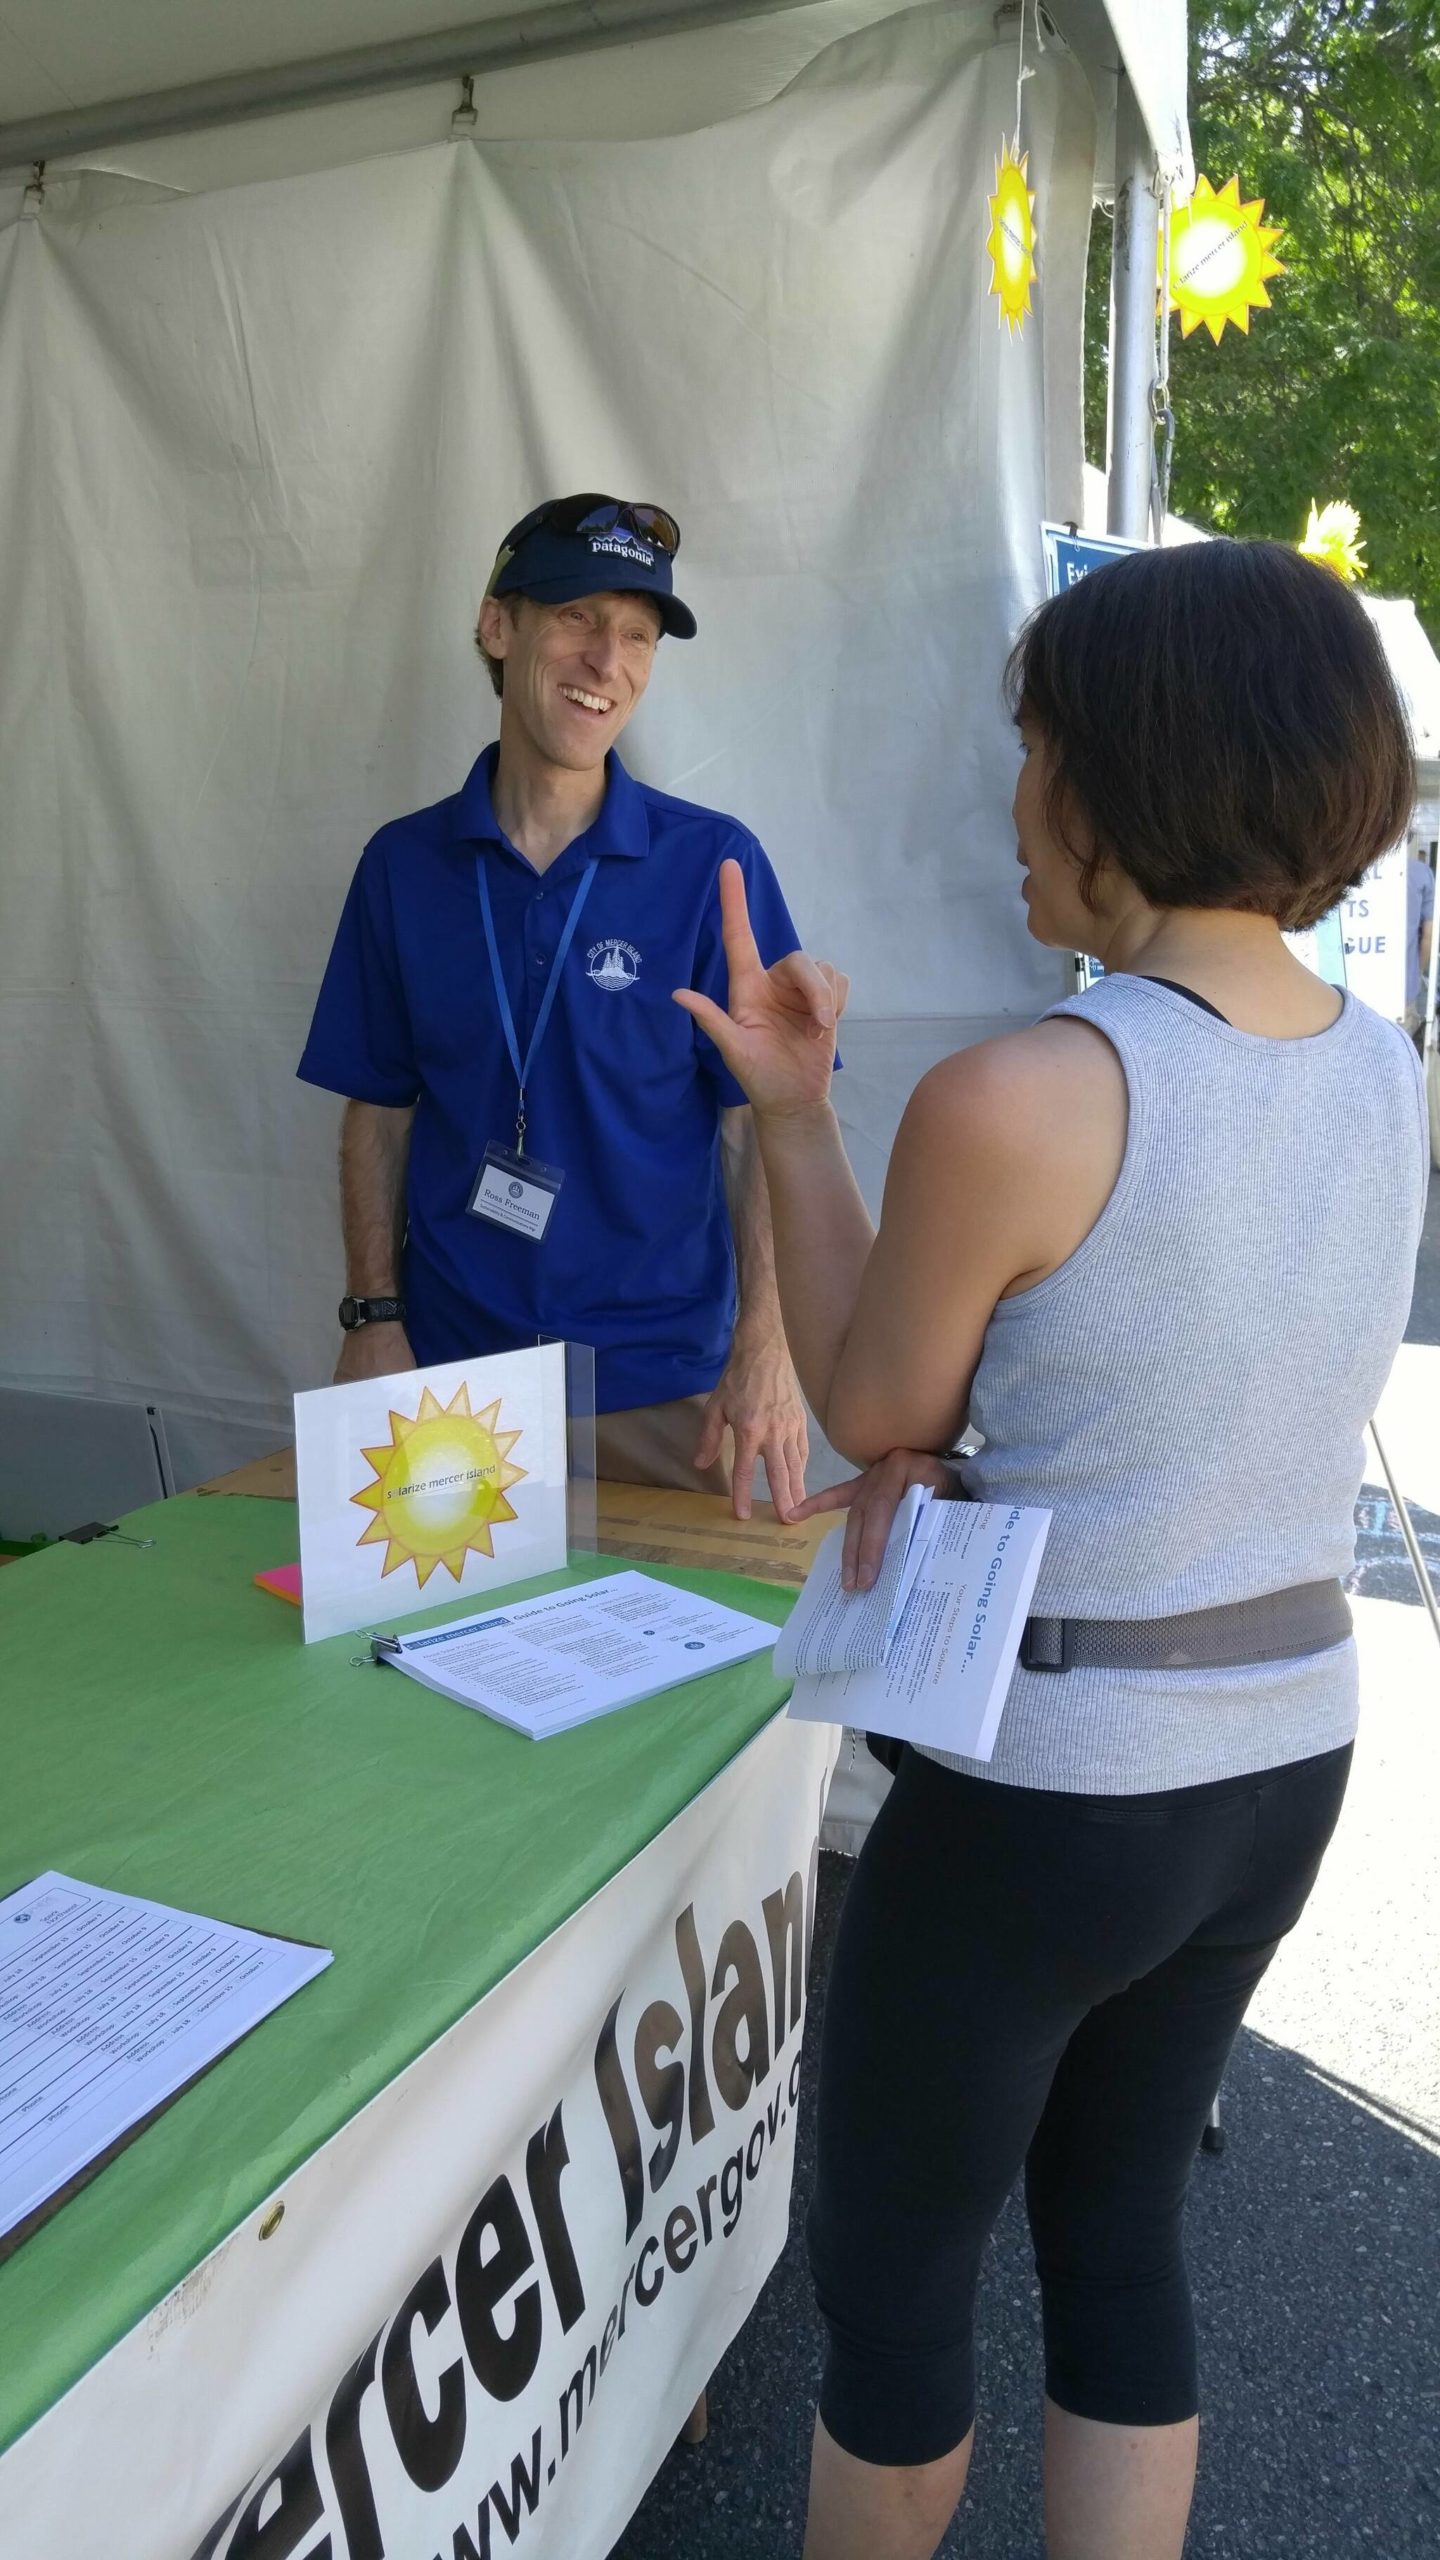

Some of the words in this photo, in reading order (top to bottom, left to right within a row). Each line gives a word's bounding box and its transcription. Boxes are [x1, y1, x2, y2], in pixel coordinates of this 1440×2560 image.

[592, 542, 652, 566] patagonia
[605, 938, 628, 949] MERCER
[484, 1188, 503, 1204] Ross
[504, 1198, 540, 1220] Freeman
[429, 1473, 465, 1489] mercer
[466, 1464, 496, 1480] island
[996, 1535, 1011, 1552] to
[955, 1583, 968, 1605] Your
[977, 1557, 1002, 1608] Going
[513, 1607, 543, 1621] Guide
[543, 1605, 556, 1614] to
[556, 1596, 585, 1609] Going
[946, 1607, 960, 1632] Steps
[446, 1627, 478, 1640] mercer
[942, 1634, 951, 1646] to
[932, 1648, 948, 1685] Solarize
[124, 1969, 153, 1990] September
[167, 1944, 188, 1959] October
[148, 1977, 177, 1997] September
[191, 1951, 211, 1966] October
[172, 1985, 201, 2005] September
[215, 1958, 235, 1973] October
[197, 1991, 225, 2012] September
[240, 1965, 259, 1979] October
[190, 2098, 586, 2560] ercer
